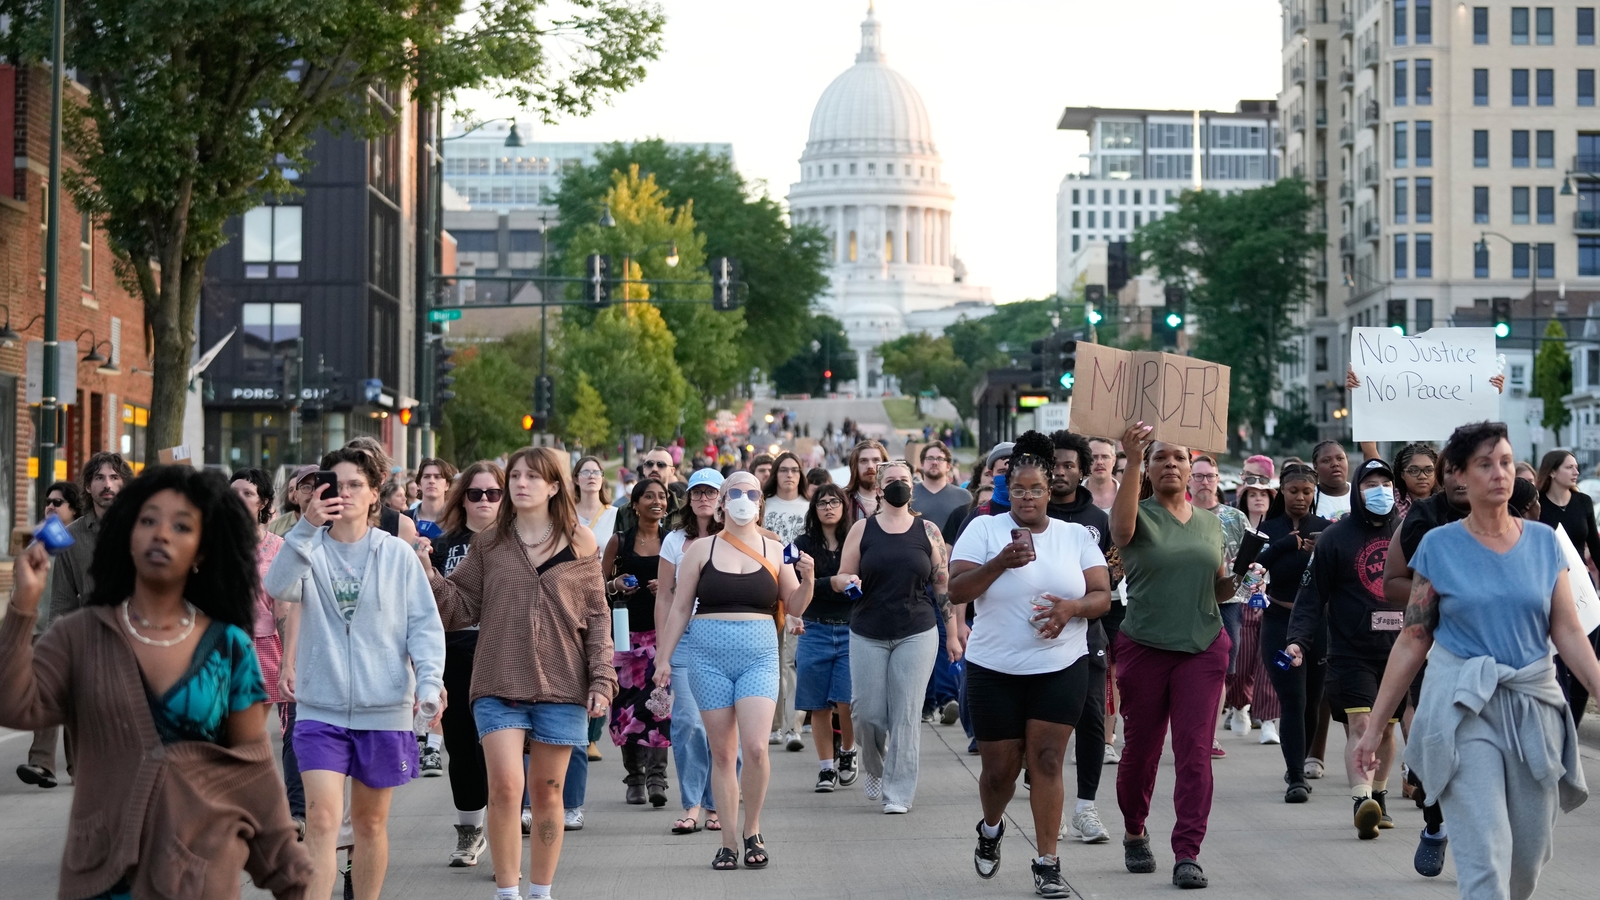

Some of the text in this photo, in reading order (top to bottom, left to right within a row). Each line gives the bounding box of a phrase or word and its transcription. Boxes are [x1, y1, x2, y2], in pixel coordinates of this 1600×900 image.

[433, 311, 450, 320] Blair
[1359, 332, 1477, 366] No Justice
[1090, 356, 1223, 434] MURDER
[1366, 374, 1397, 402] No
[1046, 420, 1065, 428] TURN
[448, 544, 460, 557] IF
